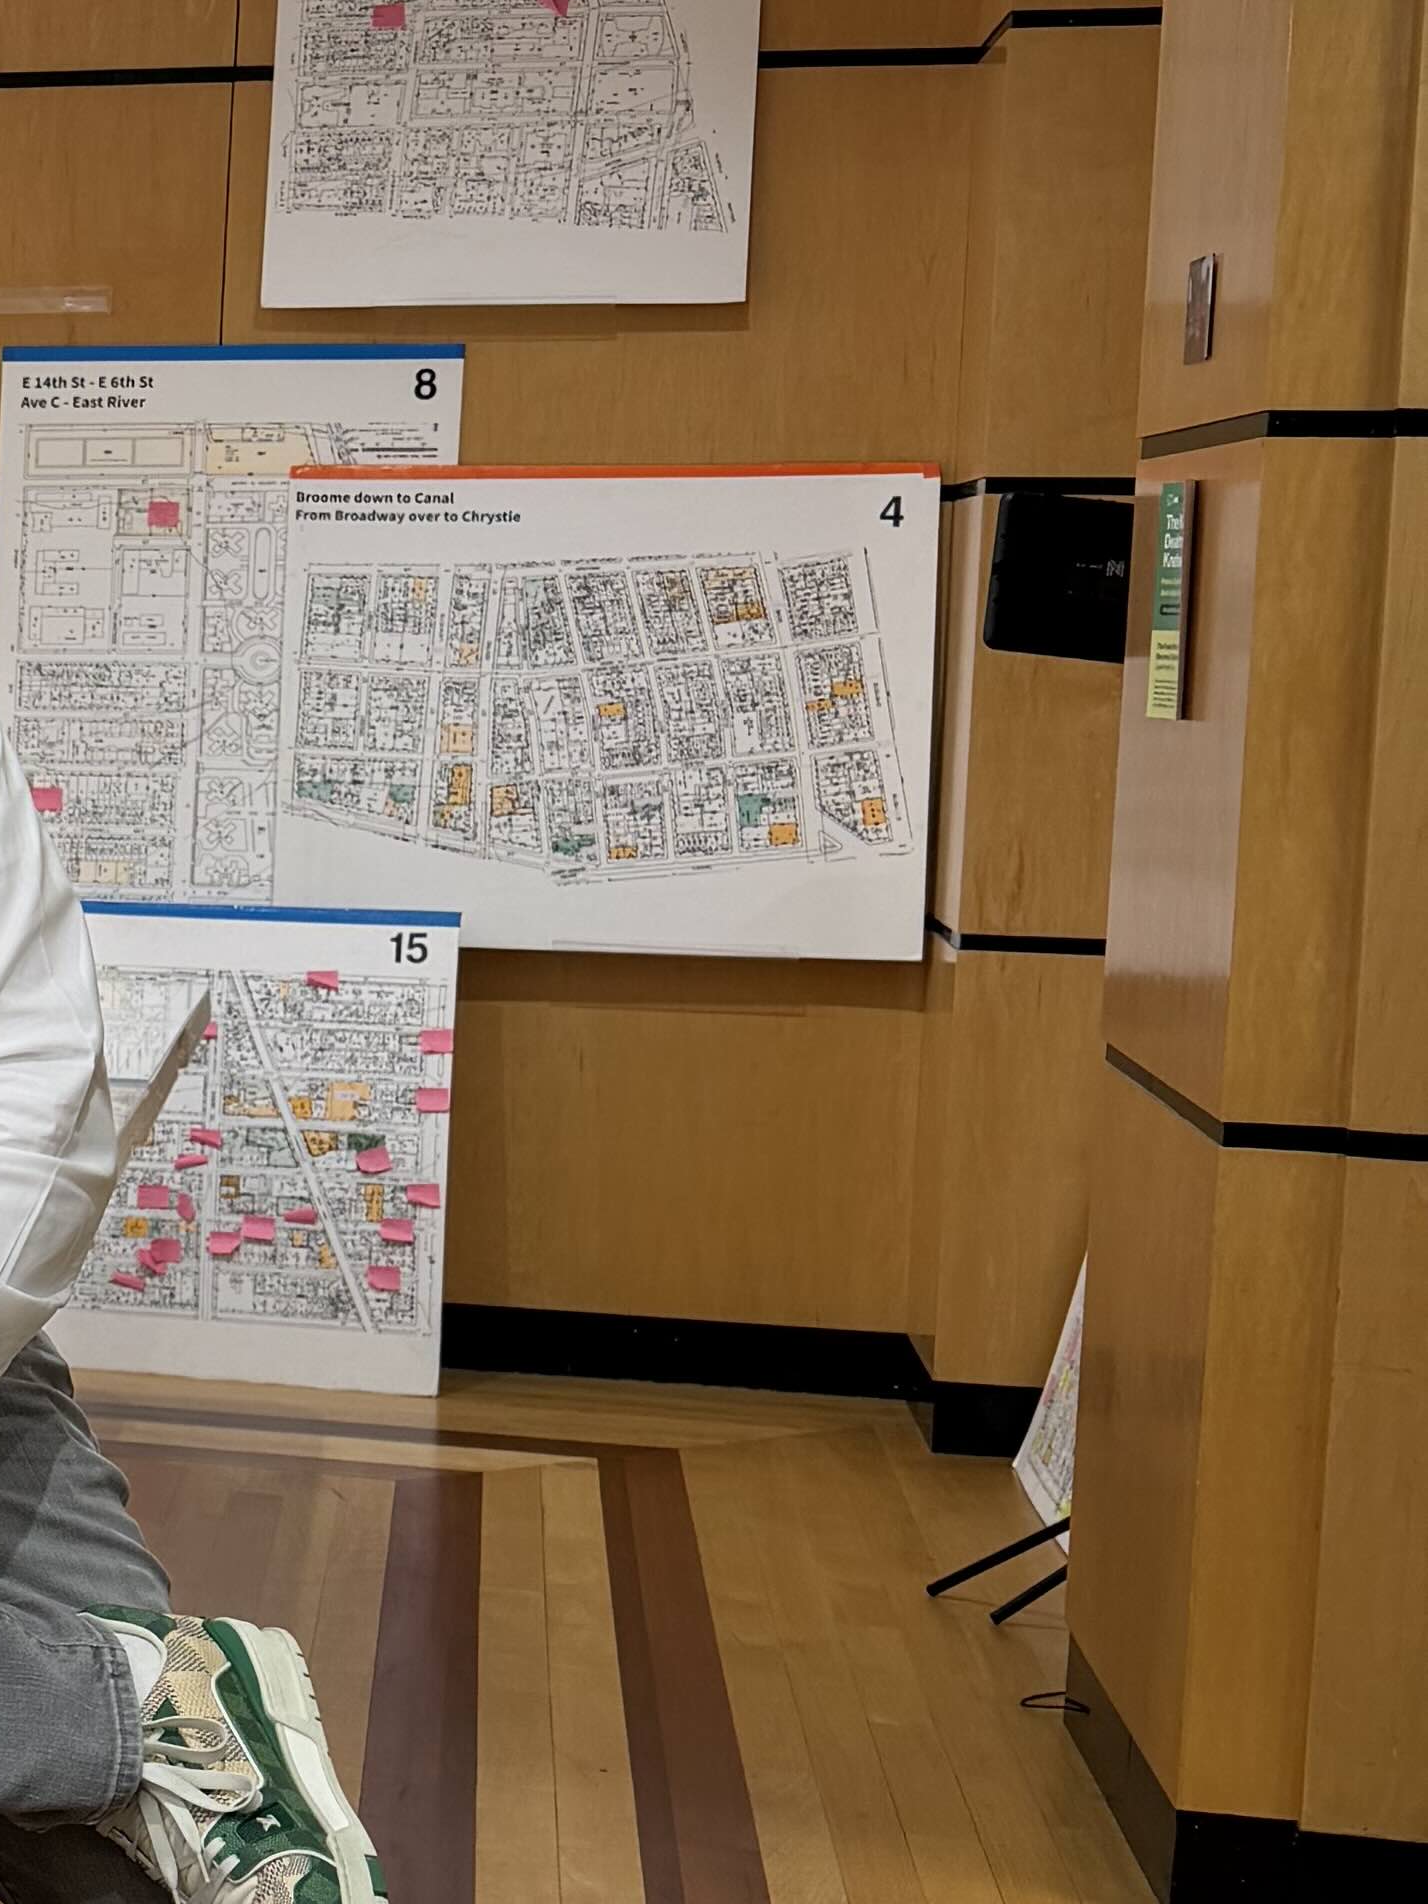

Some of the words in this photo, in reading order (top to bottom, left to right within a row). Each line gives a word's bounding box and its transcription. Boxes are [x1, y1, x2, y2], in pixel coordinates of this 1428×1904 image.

[22, 376, 31, 389] E
[34, 376, 68, 389] 14th
[71, 376, 86, 389] St
[99, 376, 107, 389] E
[110, 376, 136, 389] 6th
[139, 376, 154, 389] St
[413, 368, 437, 401] 8
[21, 396, 47, 409] Ave
[50, 396, 61, 409] C
[72, 396, 103, 409] East
[107, 395, 146, 409] River
[295, 491, 350, 504] Broome
[353, 491, 393, 504] down
[396, 492, 411, 504] to
[414, 491, 455, 504] Canal
[295, 510, 331, 522] From
[335, 509, 405, 526] Broadway
[409, 512, 441, 523] over
[444, 511, 459, 523] to
[462, 509, 521, 526] Chrystie
[879, 496, 905, 527] 4
[390, 932, 429, 964] 15
